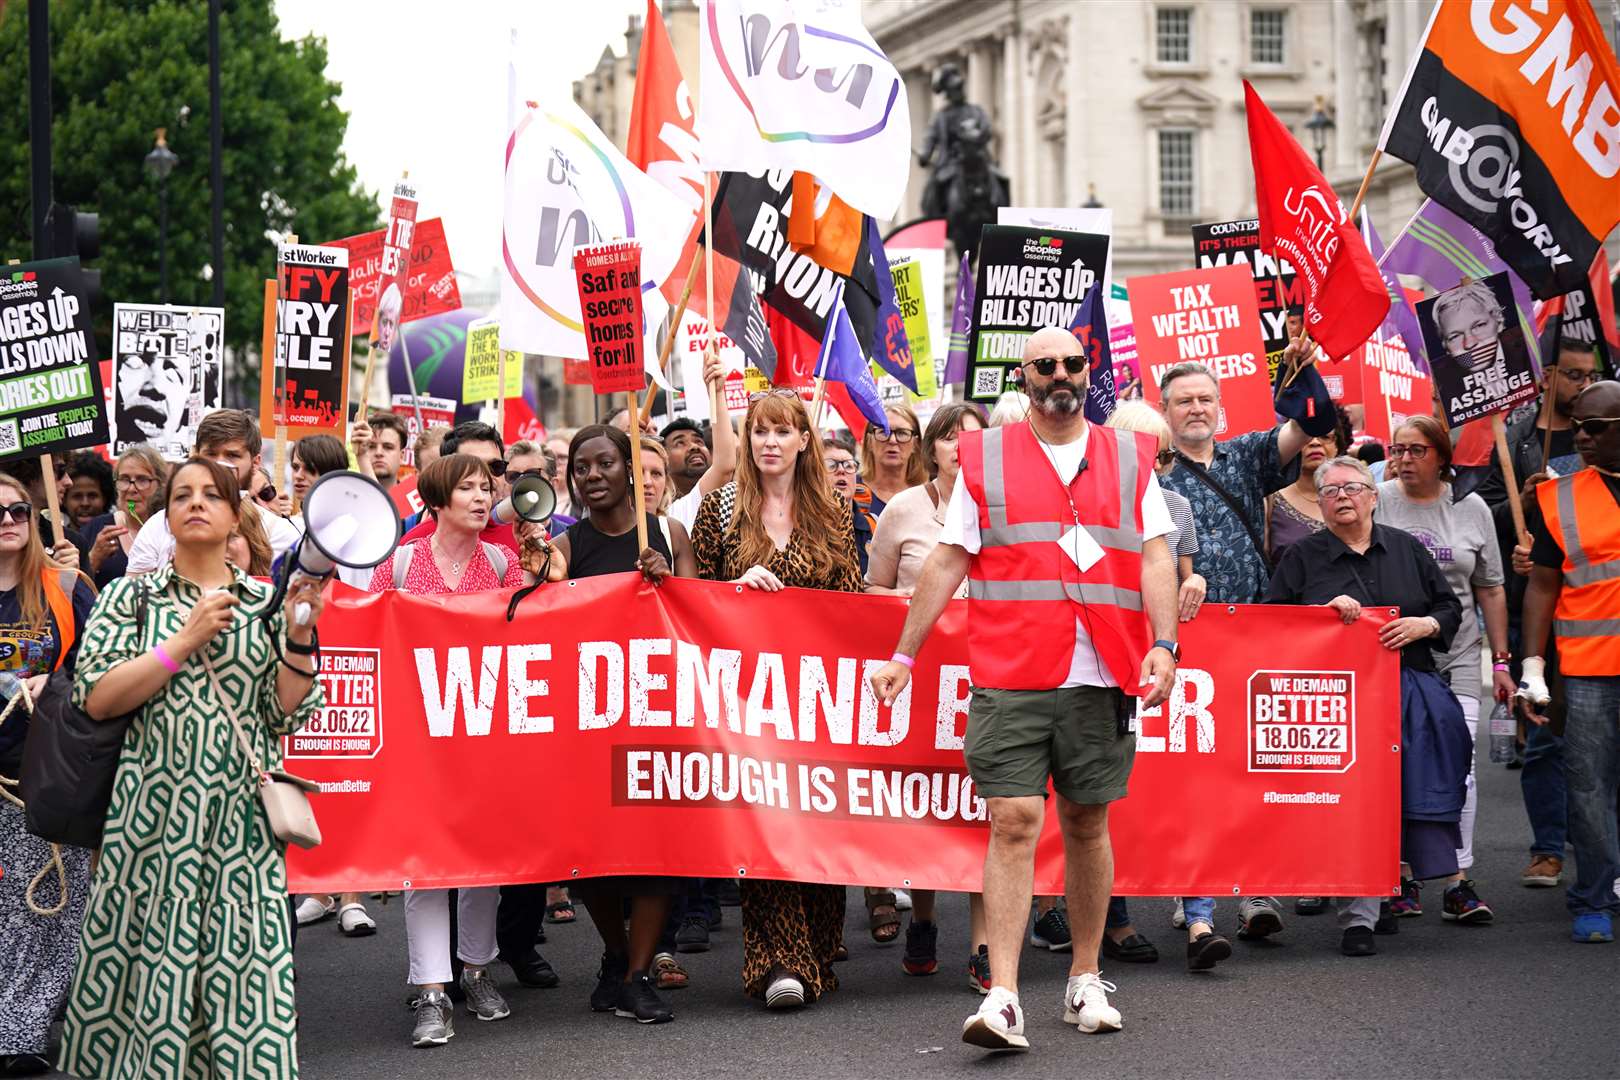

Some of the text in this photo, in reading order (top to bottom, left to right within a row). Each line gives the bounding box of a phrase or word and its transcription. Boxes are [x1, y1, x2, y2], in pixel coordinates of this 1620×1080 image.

[1023, 244, 1062, 256] peoples
[1026, 238, 1038, 246] the
[297, 249, 337, 265] Worker
[1024, 252, 1060, 263] assembly
[2, 289, 38, 300] assembly
[986, 262, 1095, 300] WAGES UP
[47, 290, 80, 332] UP
[1170, 283, 1214, 311] TAX
[980, 299, 1031, 327] BILLS
[1031, 301, 1083, 328] DOW
[1152, 305, 1240, 338] WEALTH
[26, 331, 88, 367] DOWN
[1178, 332, 1219, 360] NOT
[49, 367, 88, 401] OUT
[1463, 358, 1509, 391] FREE
[1450, 370, 1532, 413] ASSANGE
[1453, 413, 1466, 423] NO
[1482, 386, 1534, 412] EXTRADITION
[21, 404, 99, 433] JOIN THE PEOPLE'S
[290, 414, 319, 424] occupy
[23, 420, 94, 447] ASSEMBLY TODAY
[334, 656, 374, 672] DEMAND
[413, 643, 554, 737] WE
[578, 638, 912, 747] DEMAND
[1270, 678, 1346, 692] WE DEMAND
[1256, 694, 1347, 722] BETTER
[294, 738, 370, 751] ENOUGH IS ENOUGH
[1261, 727, 1341, 749] 18.06.22
[1256, 754, 1341, 766] ENOUGH IS ENOUGH
[627, 750, 992, 823] ENOUGH IS ENOUG
[1263, 791, 1341, 804] #DemandBetter
